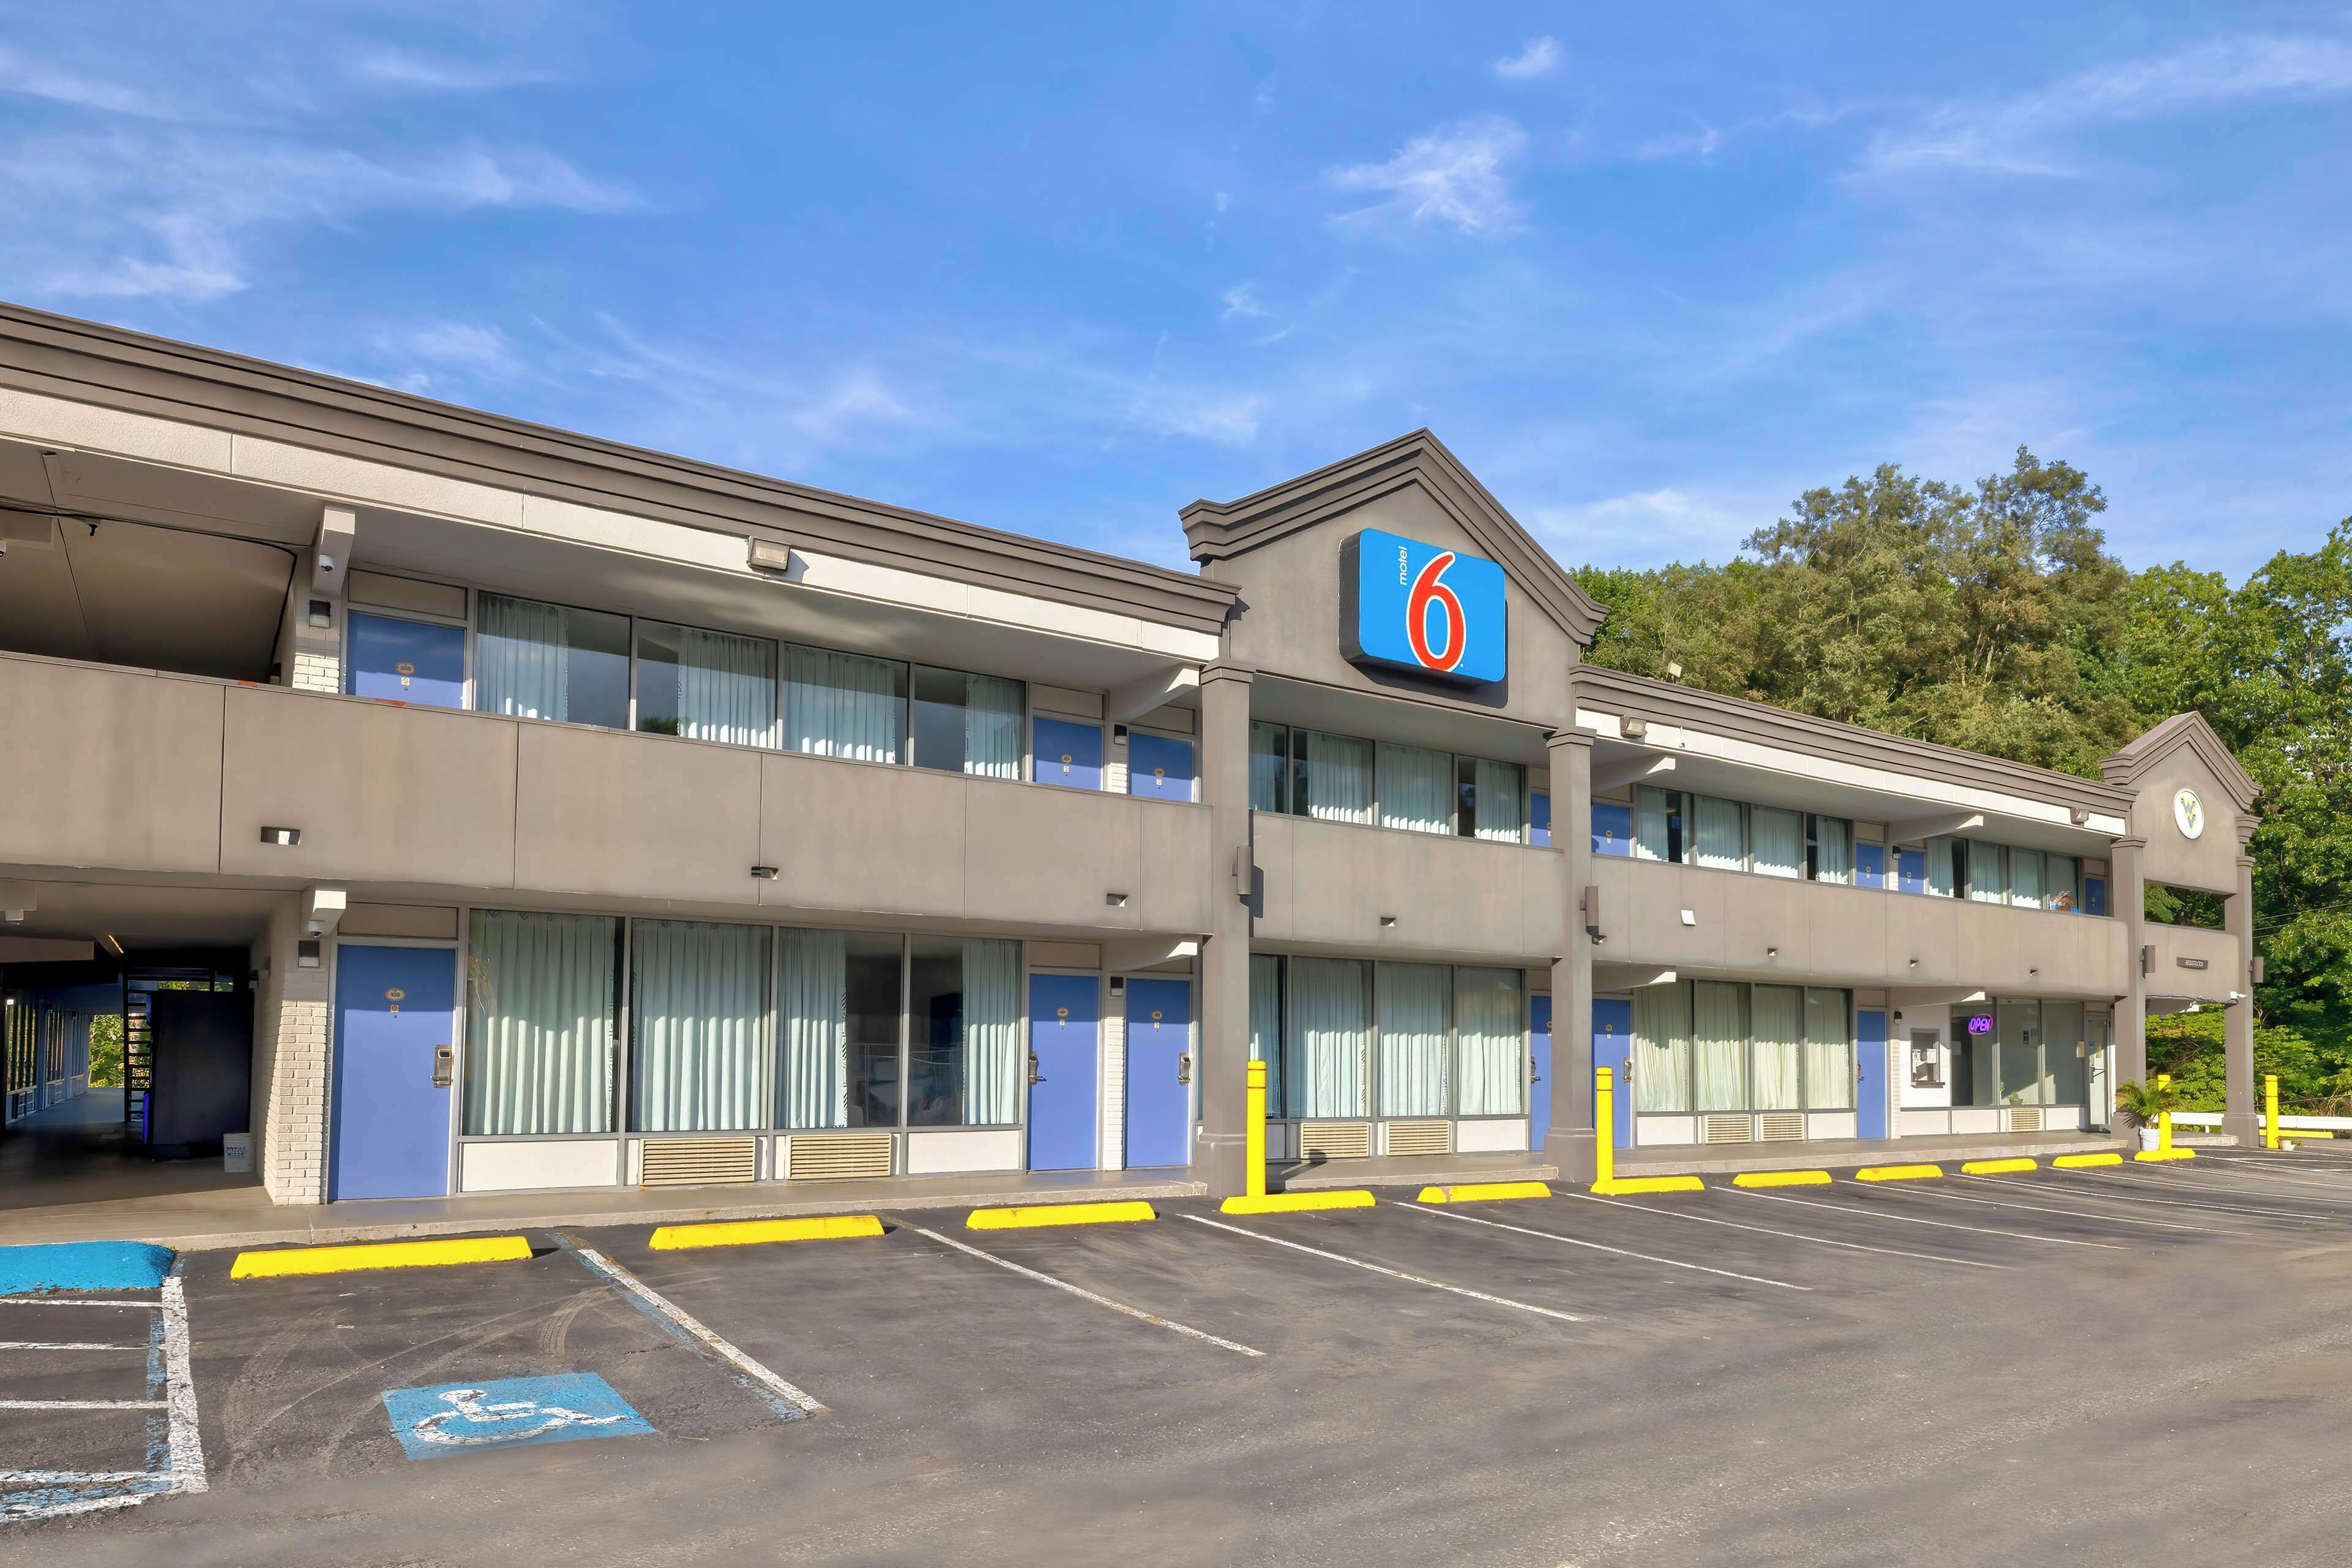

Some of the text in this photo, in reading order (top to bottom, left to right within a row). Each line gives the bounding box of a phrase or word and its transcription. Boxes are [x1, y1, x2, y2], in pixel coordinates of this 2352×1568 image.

[1398, 546, 1466, 672] motel 6
[1970, 1017, 1991, 1031] OPEN
